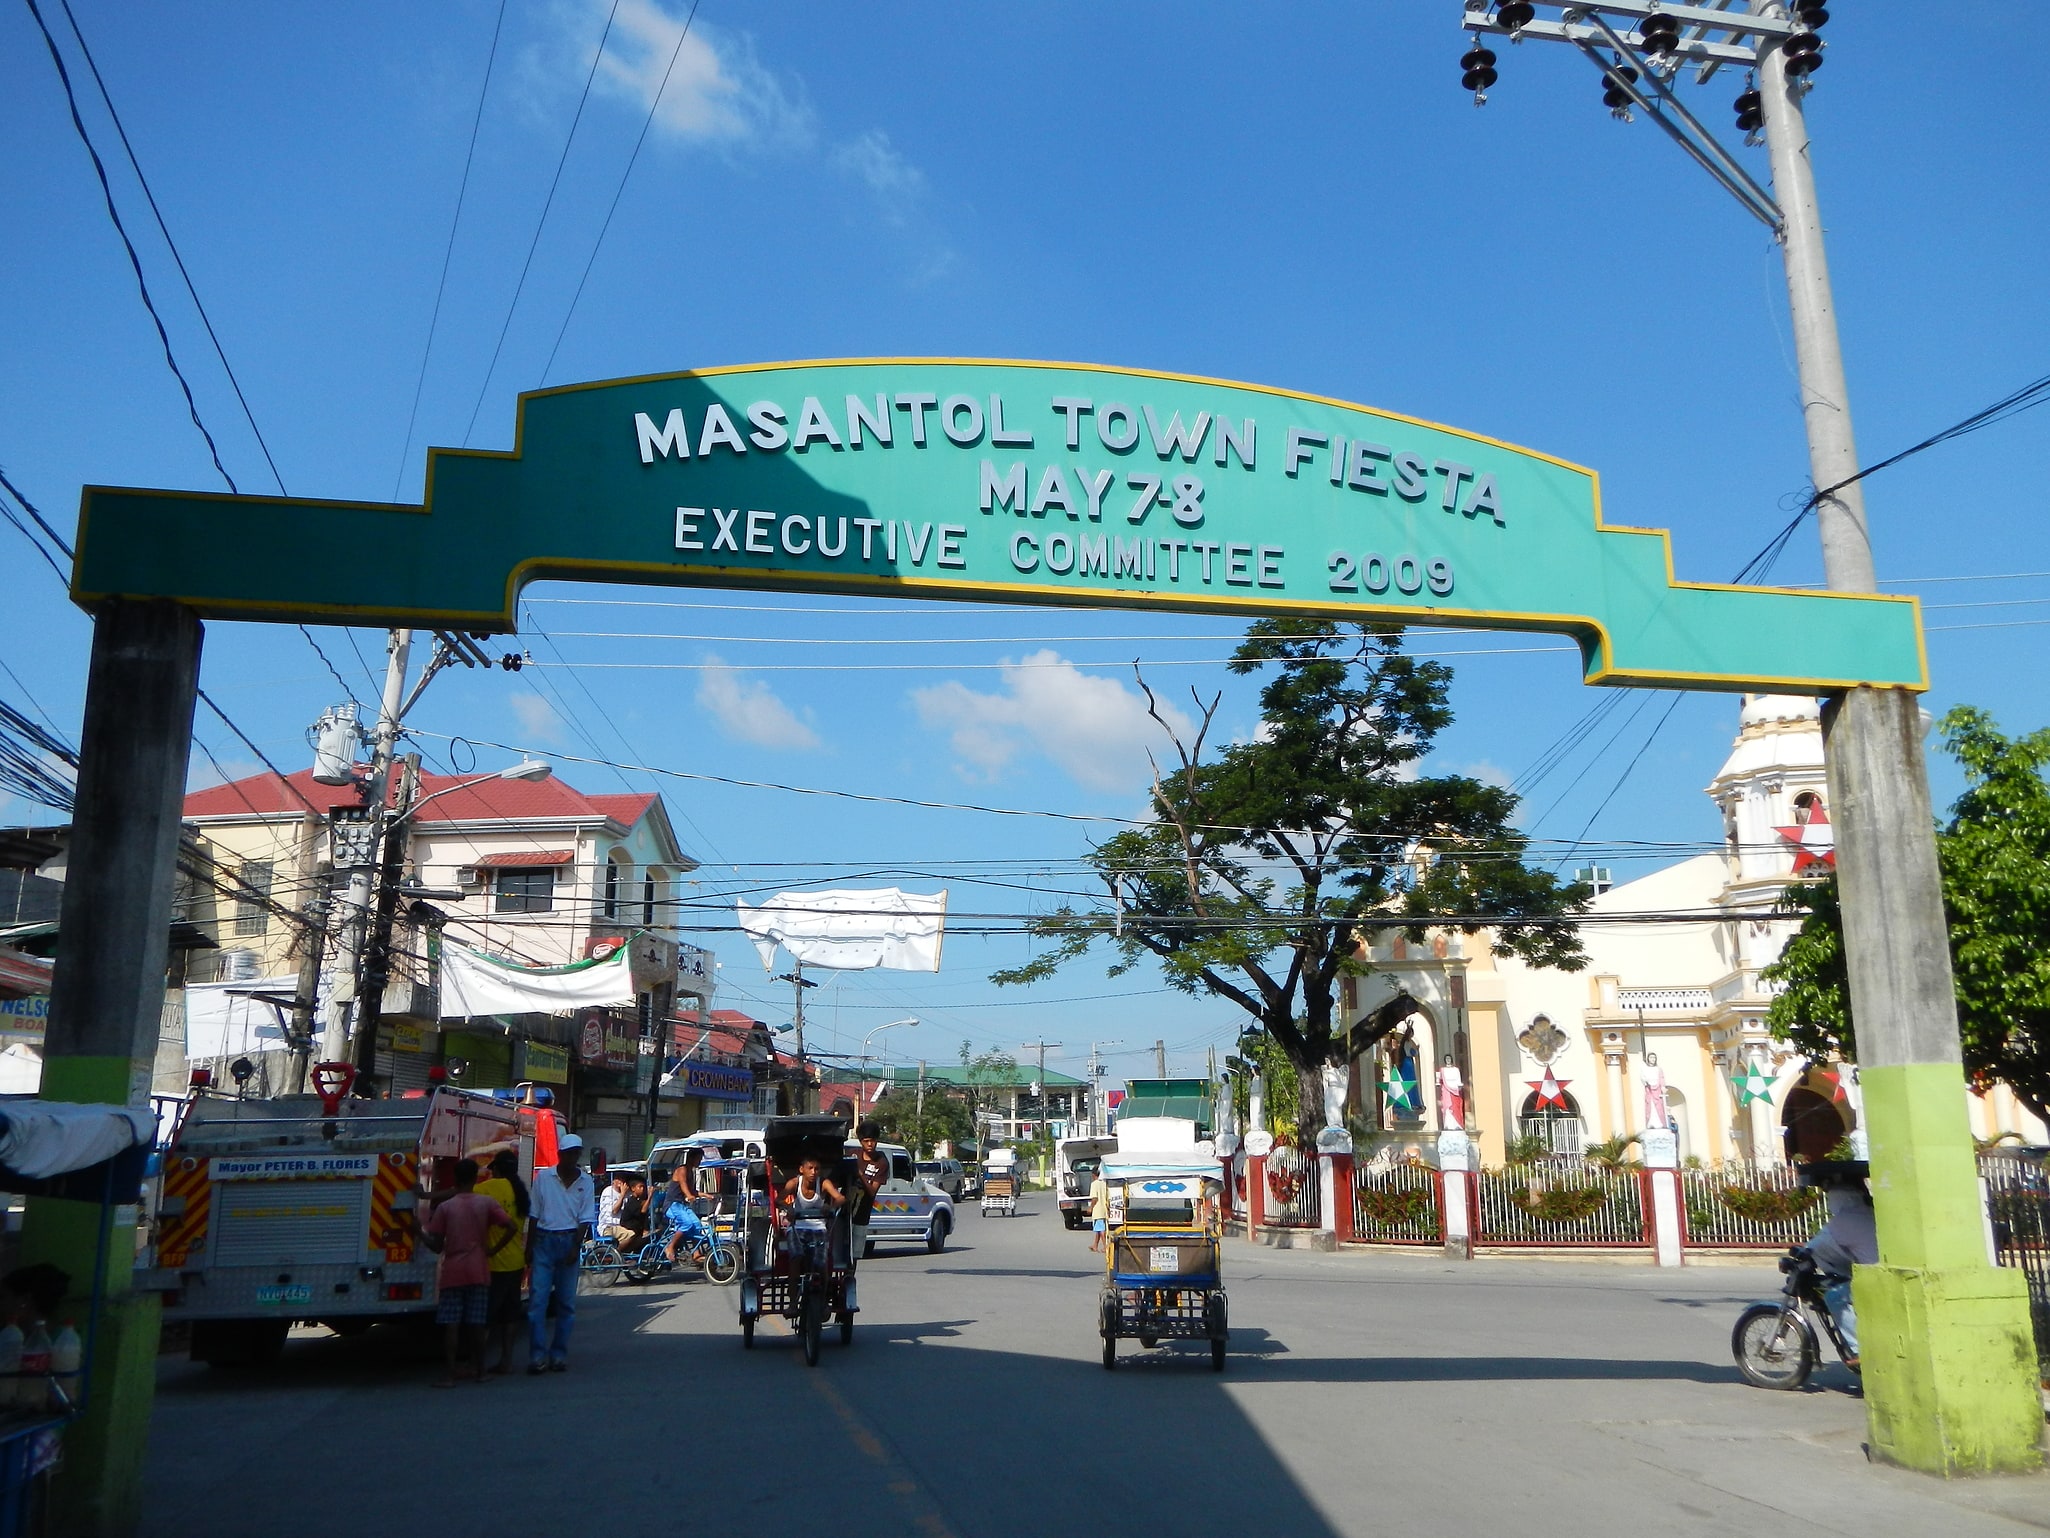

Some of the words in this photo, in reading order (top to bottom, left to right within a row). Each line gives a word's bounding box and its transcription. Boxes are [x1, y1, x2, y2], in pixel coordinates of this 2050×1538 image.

[634, 393, 1034, 464] MASANTOL
[1051, 396, 1256, 470] TOWN
[1285, 426, 1506, 528] FIESTA
[980, 459, 1114, 520] MAY
[1127, 472, 1205, 529] 7-8
[675, 506, 967, 569] EXECUTIVE
[1010, 530, 1285, 588] COMMITTEE
[1328, 550, 1455, 596] 2009
[691, 1069, 727, 1090] CROWN
[727, 1074, 751, 1094] BANK
[218, 1162, 262, 1173] Mayor
[264, 1161, 306, 1171] PETER
[306, 1160, 319, 1170] B.
[322, 1159, 370, 1170] FLORES
[163, 1252, 186, 1265] BFP
[391, 1248, 407, 1261] R3
